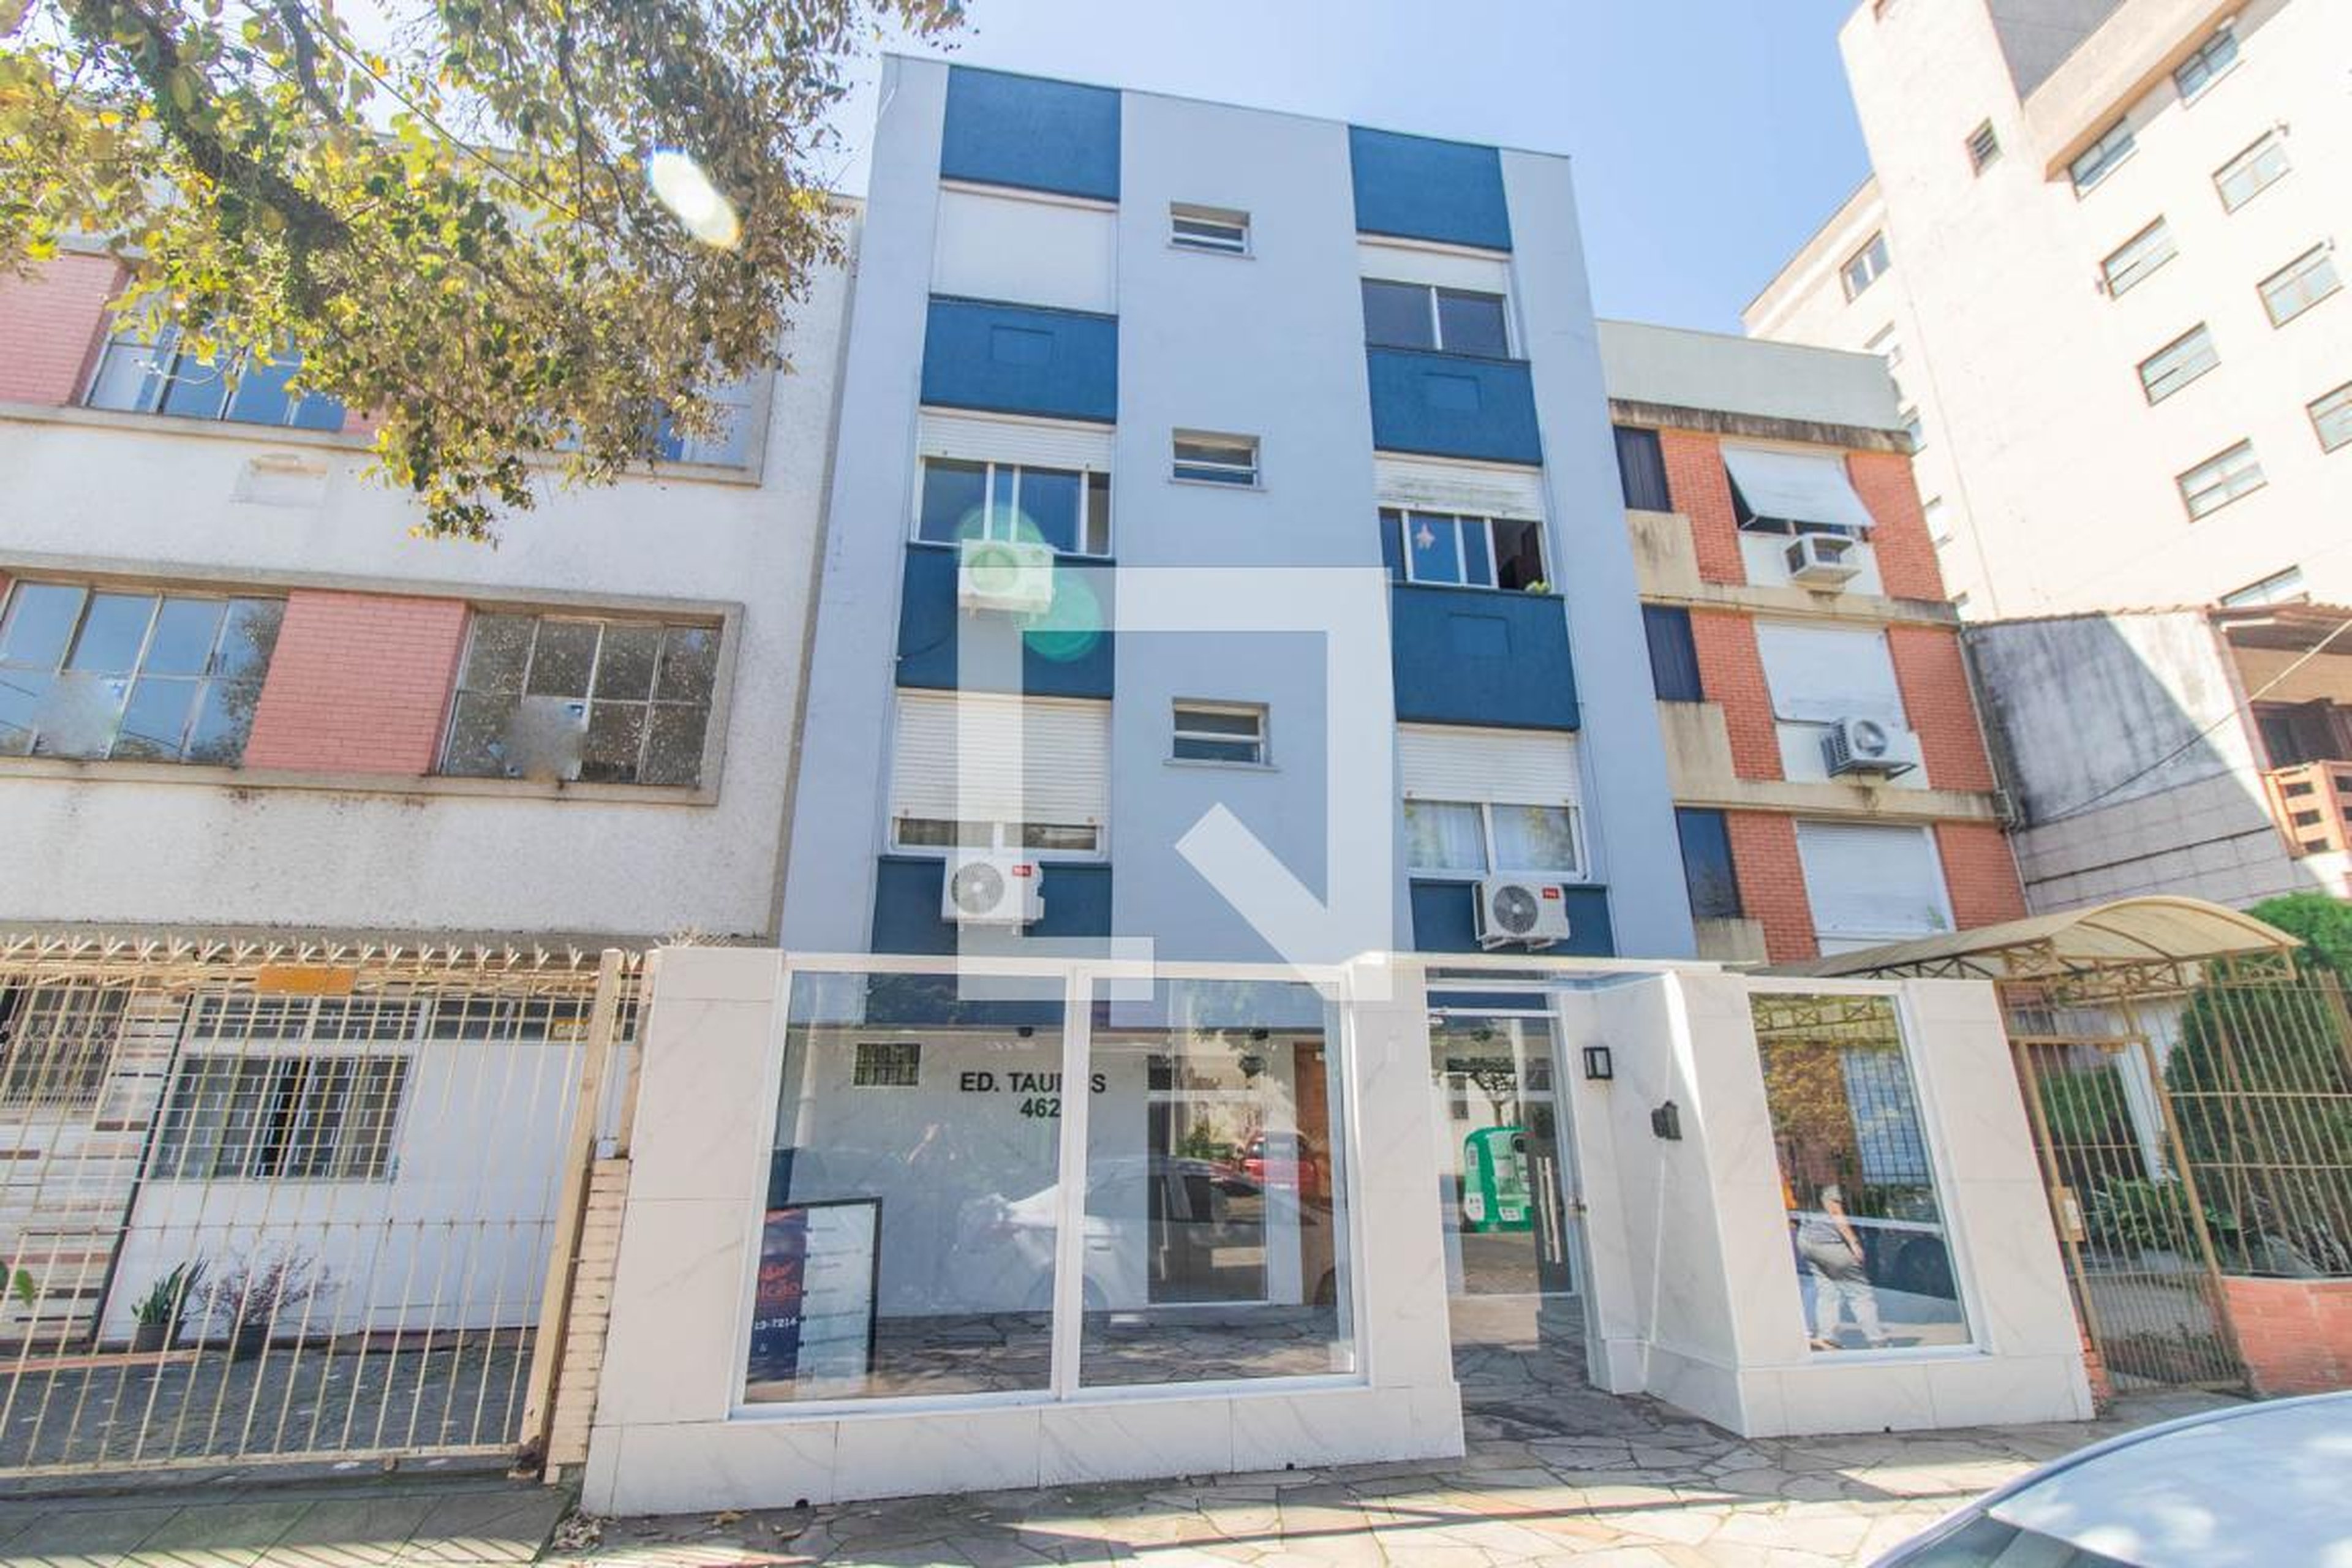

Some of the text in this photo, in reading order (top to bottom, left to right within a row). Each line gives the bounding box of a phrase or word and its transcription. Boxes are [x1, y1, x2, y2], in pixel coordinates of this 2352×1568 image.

[960, 1072, 1106, 1093] ED. TAUS
[1020, 1098, 1062, 1118] 462
